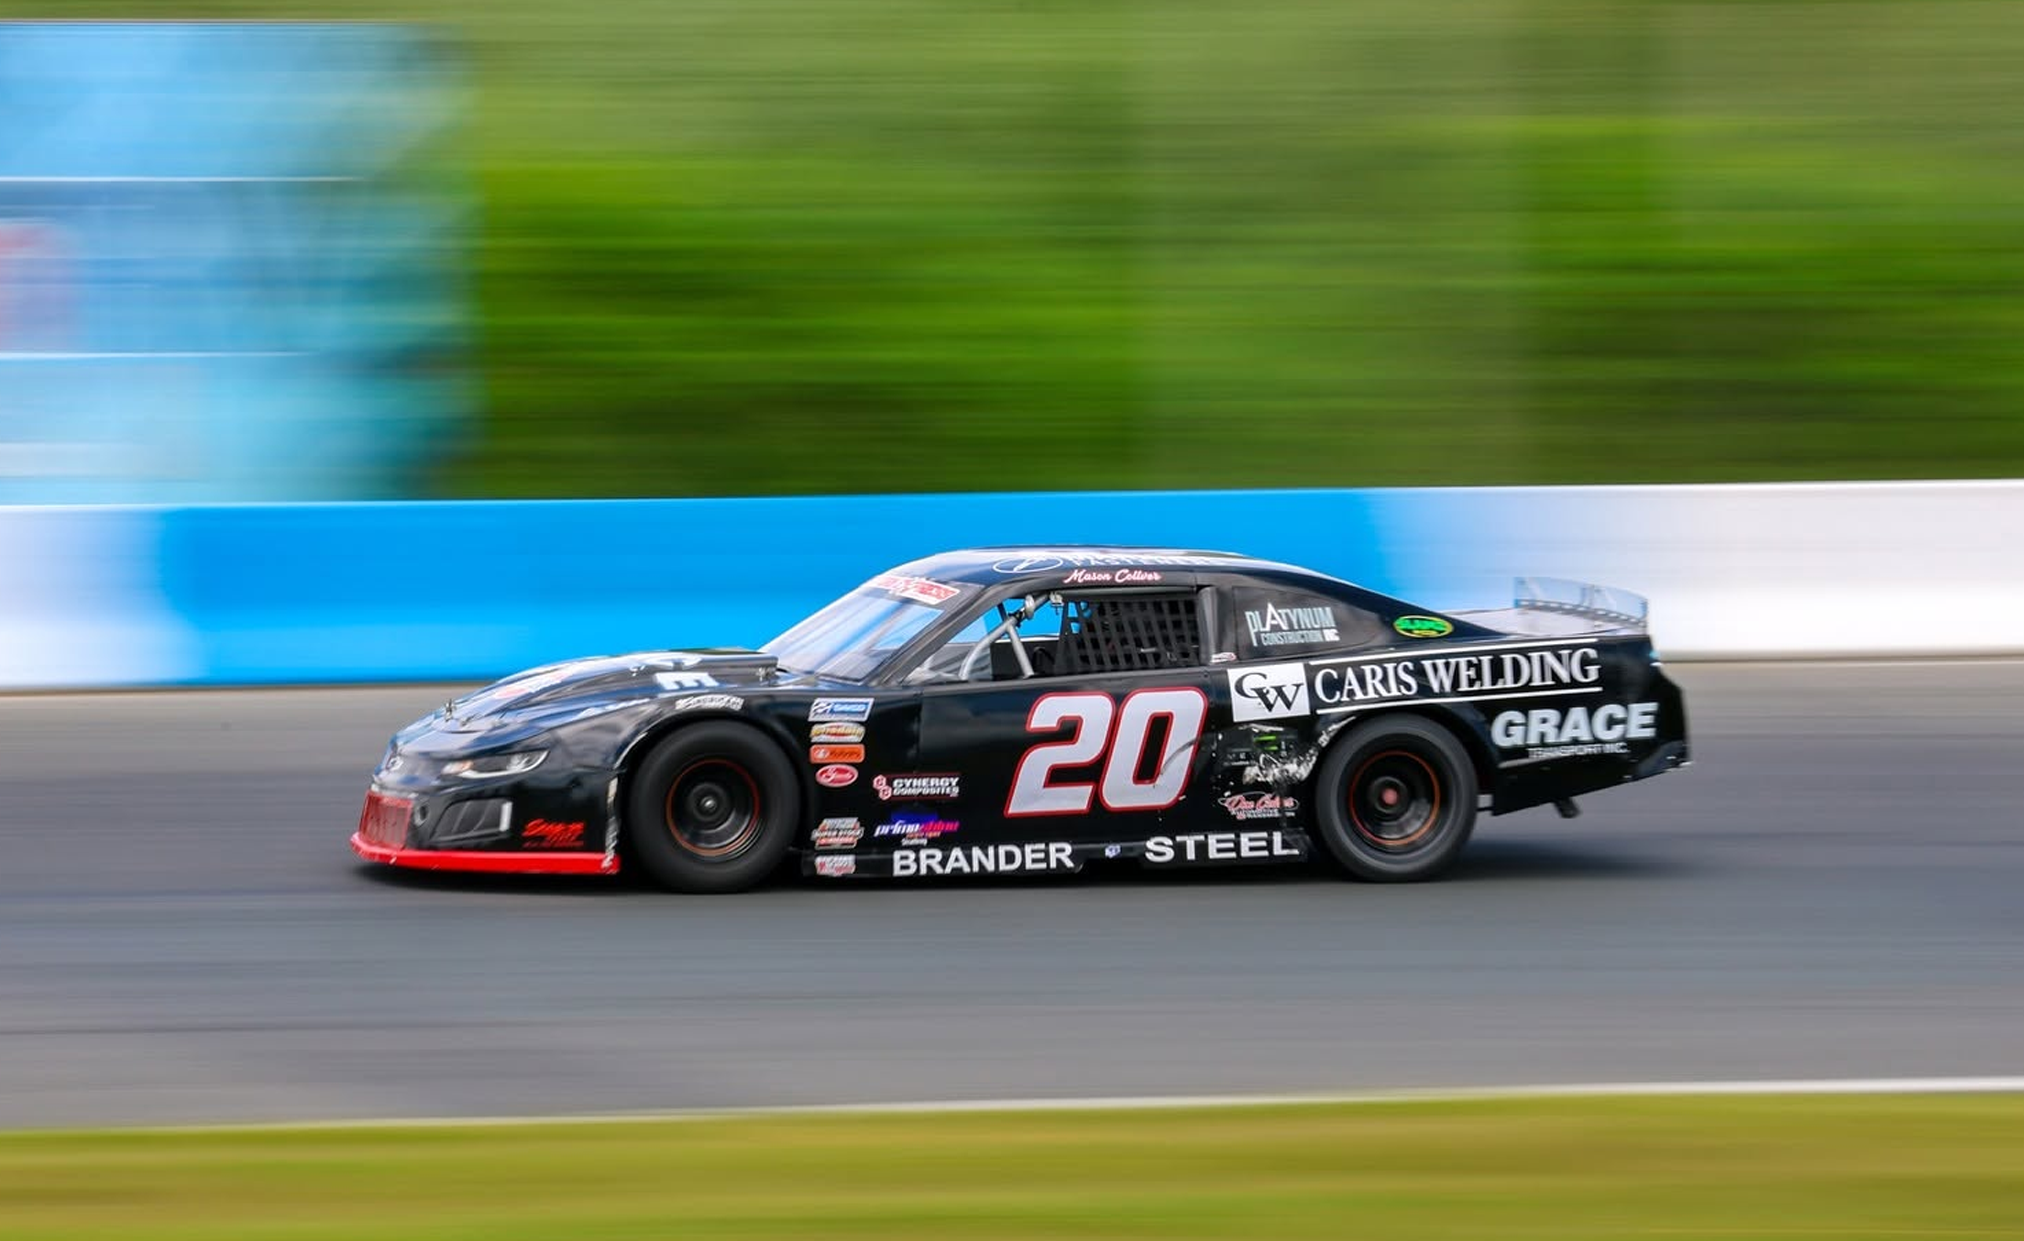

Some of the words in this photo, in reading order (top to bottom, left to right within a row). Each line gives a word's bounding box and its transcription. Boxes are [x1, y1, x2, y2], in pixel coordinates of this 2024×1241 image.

[1063, 569, 1112, 584] Mason
[1260, 630, 1324, 646] CONSTRUCTION
[1314, 661, 1419, 704] CARIS
[1421, 648, 1602, 694] WELDING
[1491, 702, 1659, 748] GRACE
[1003, 686, 1209, 818] 20
[892, 842, 1075, 877] BRANDER
[1144, 831, 1300, 862] STEEL
